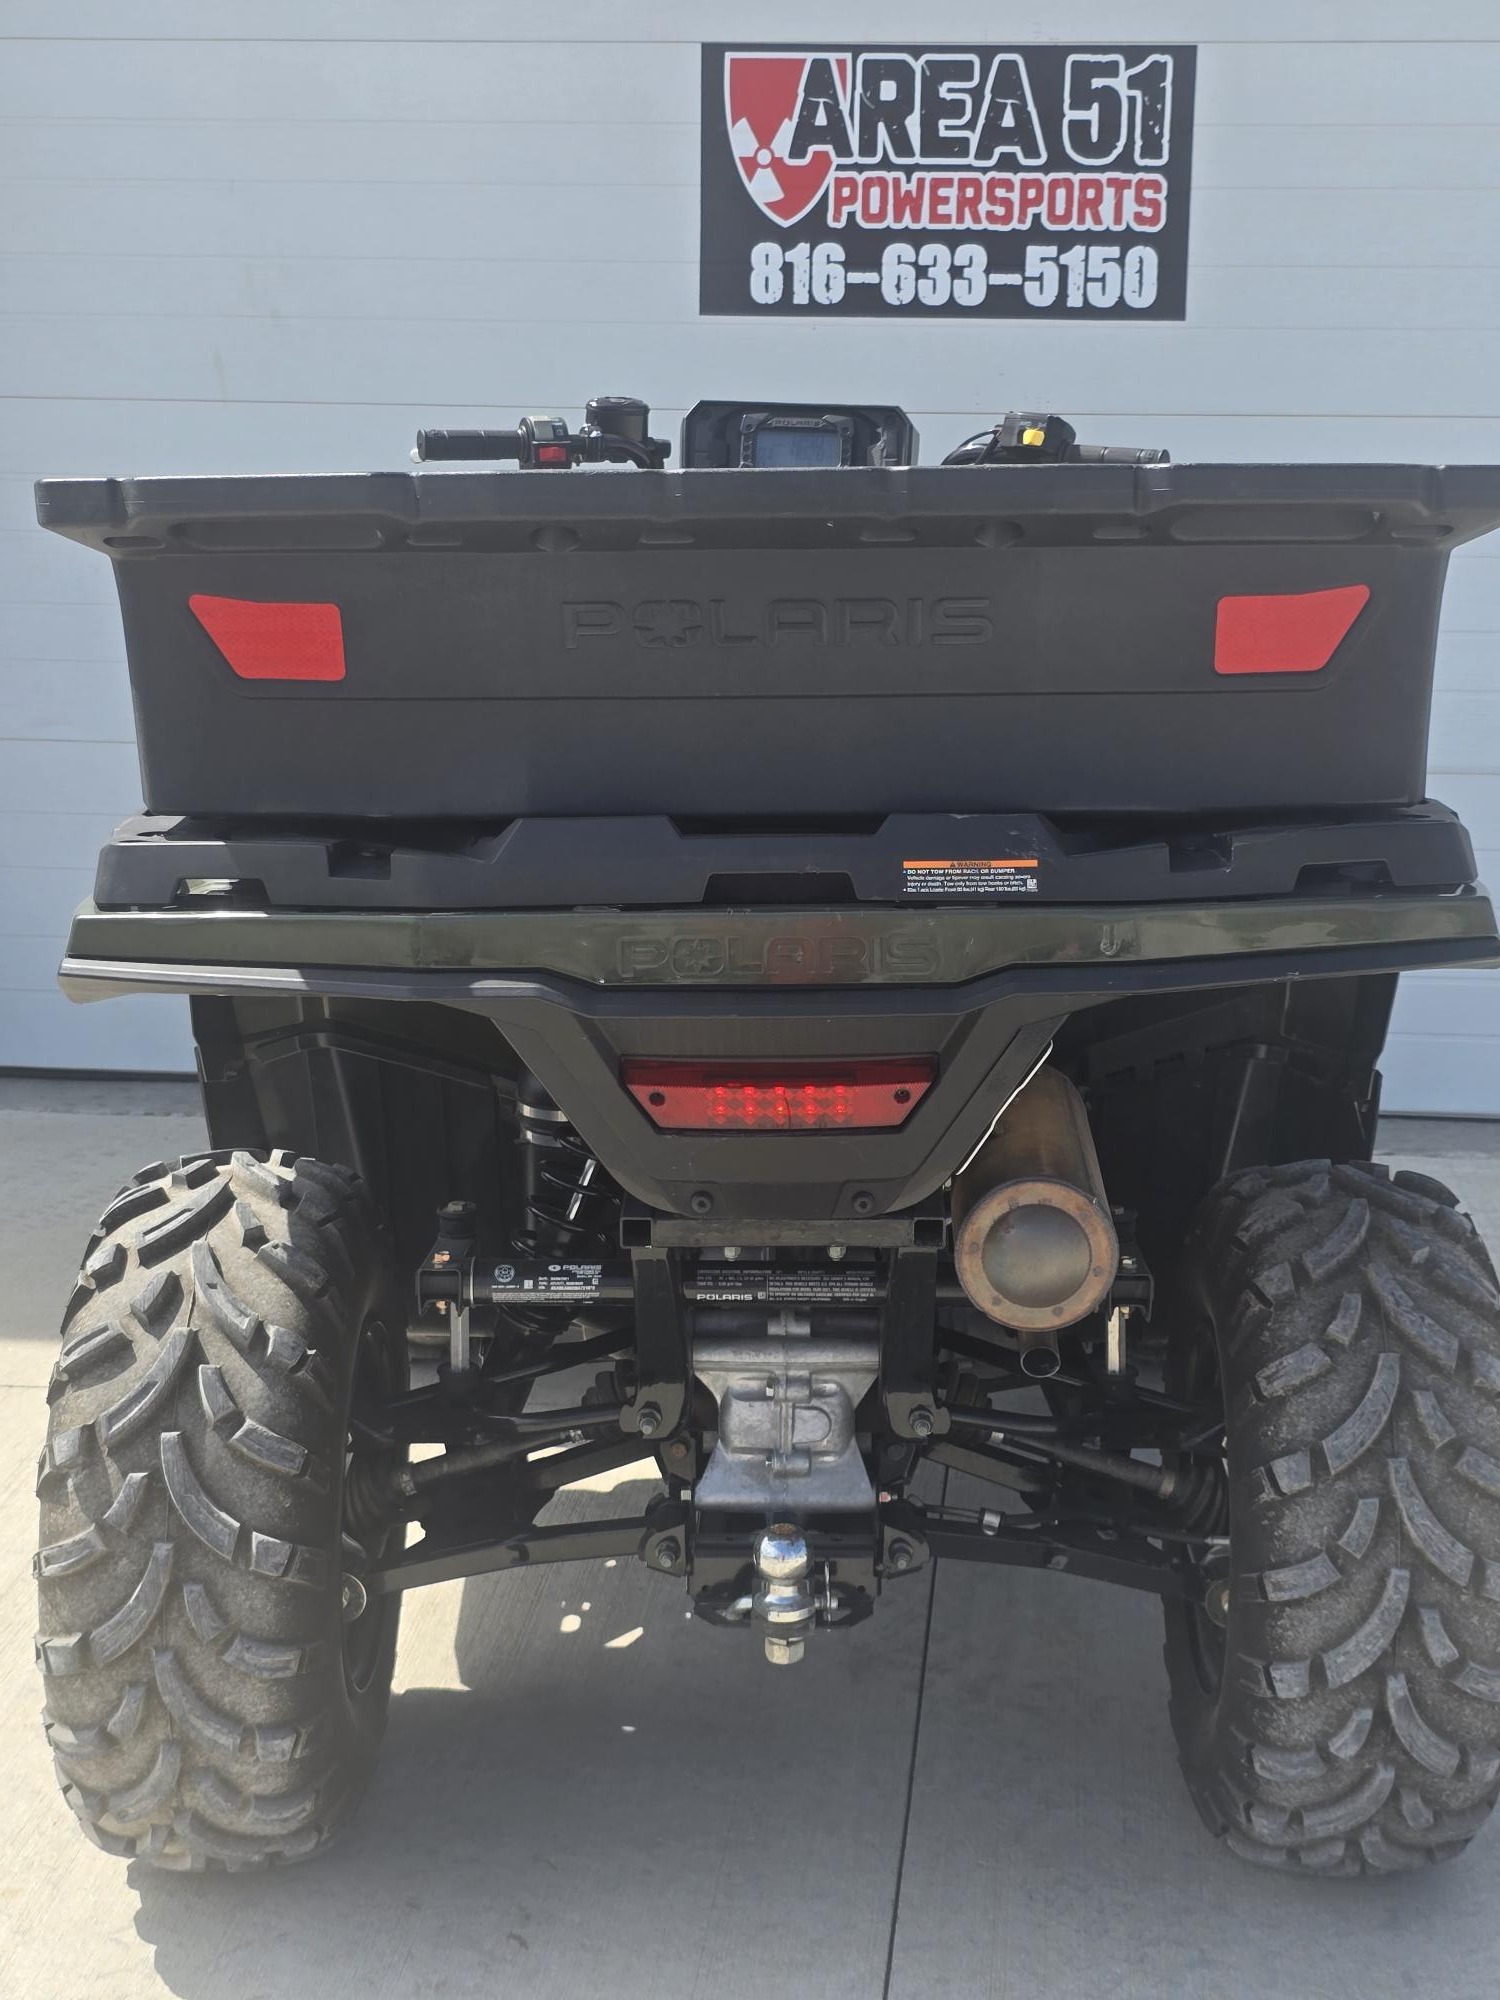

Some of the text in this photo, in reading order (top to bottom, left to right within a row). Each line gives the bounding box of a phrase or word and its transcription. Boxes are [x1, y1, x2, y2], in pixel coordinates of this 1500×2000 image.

[786, 54, 1173, 167] AREA 51
[828, 171, 1168, 232] POWERSPORTS
[749, 241, 1159, 309] 816-633-5150
[562, 599, 994, 649] POLARIS
[615, 935, 943, 978] POLARIS
